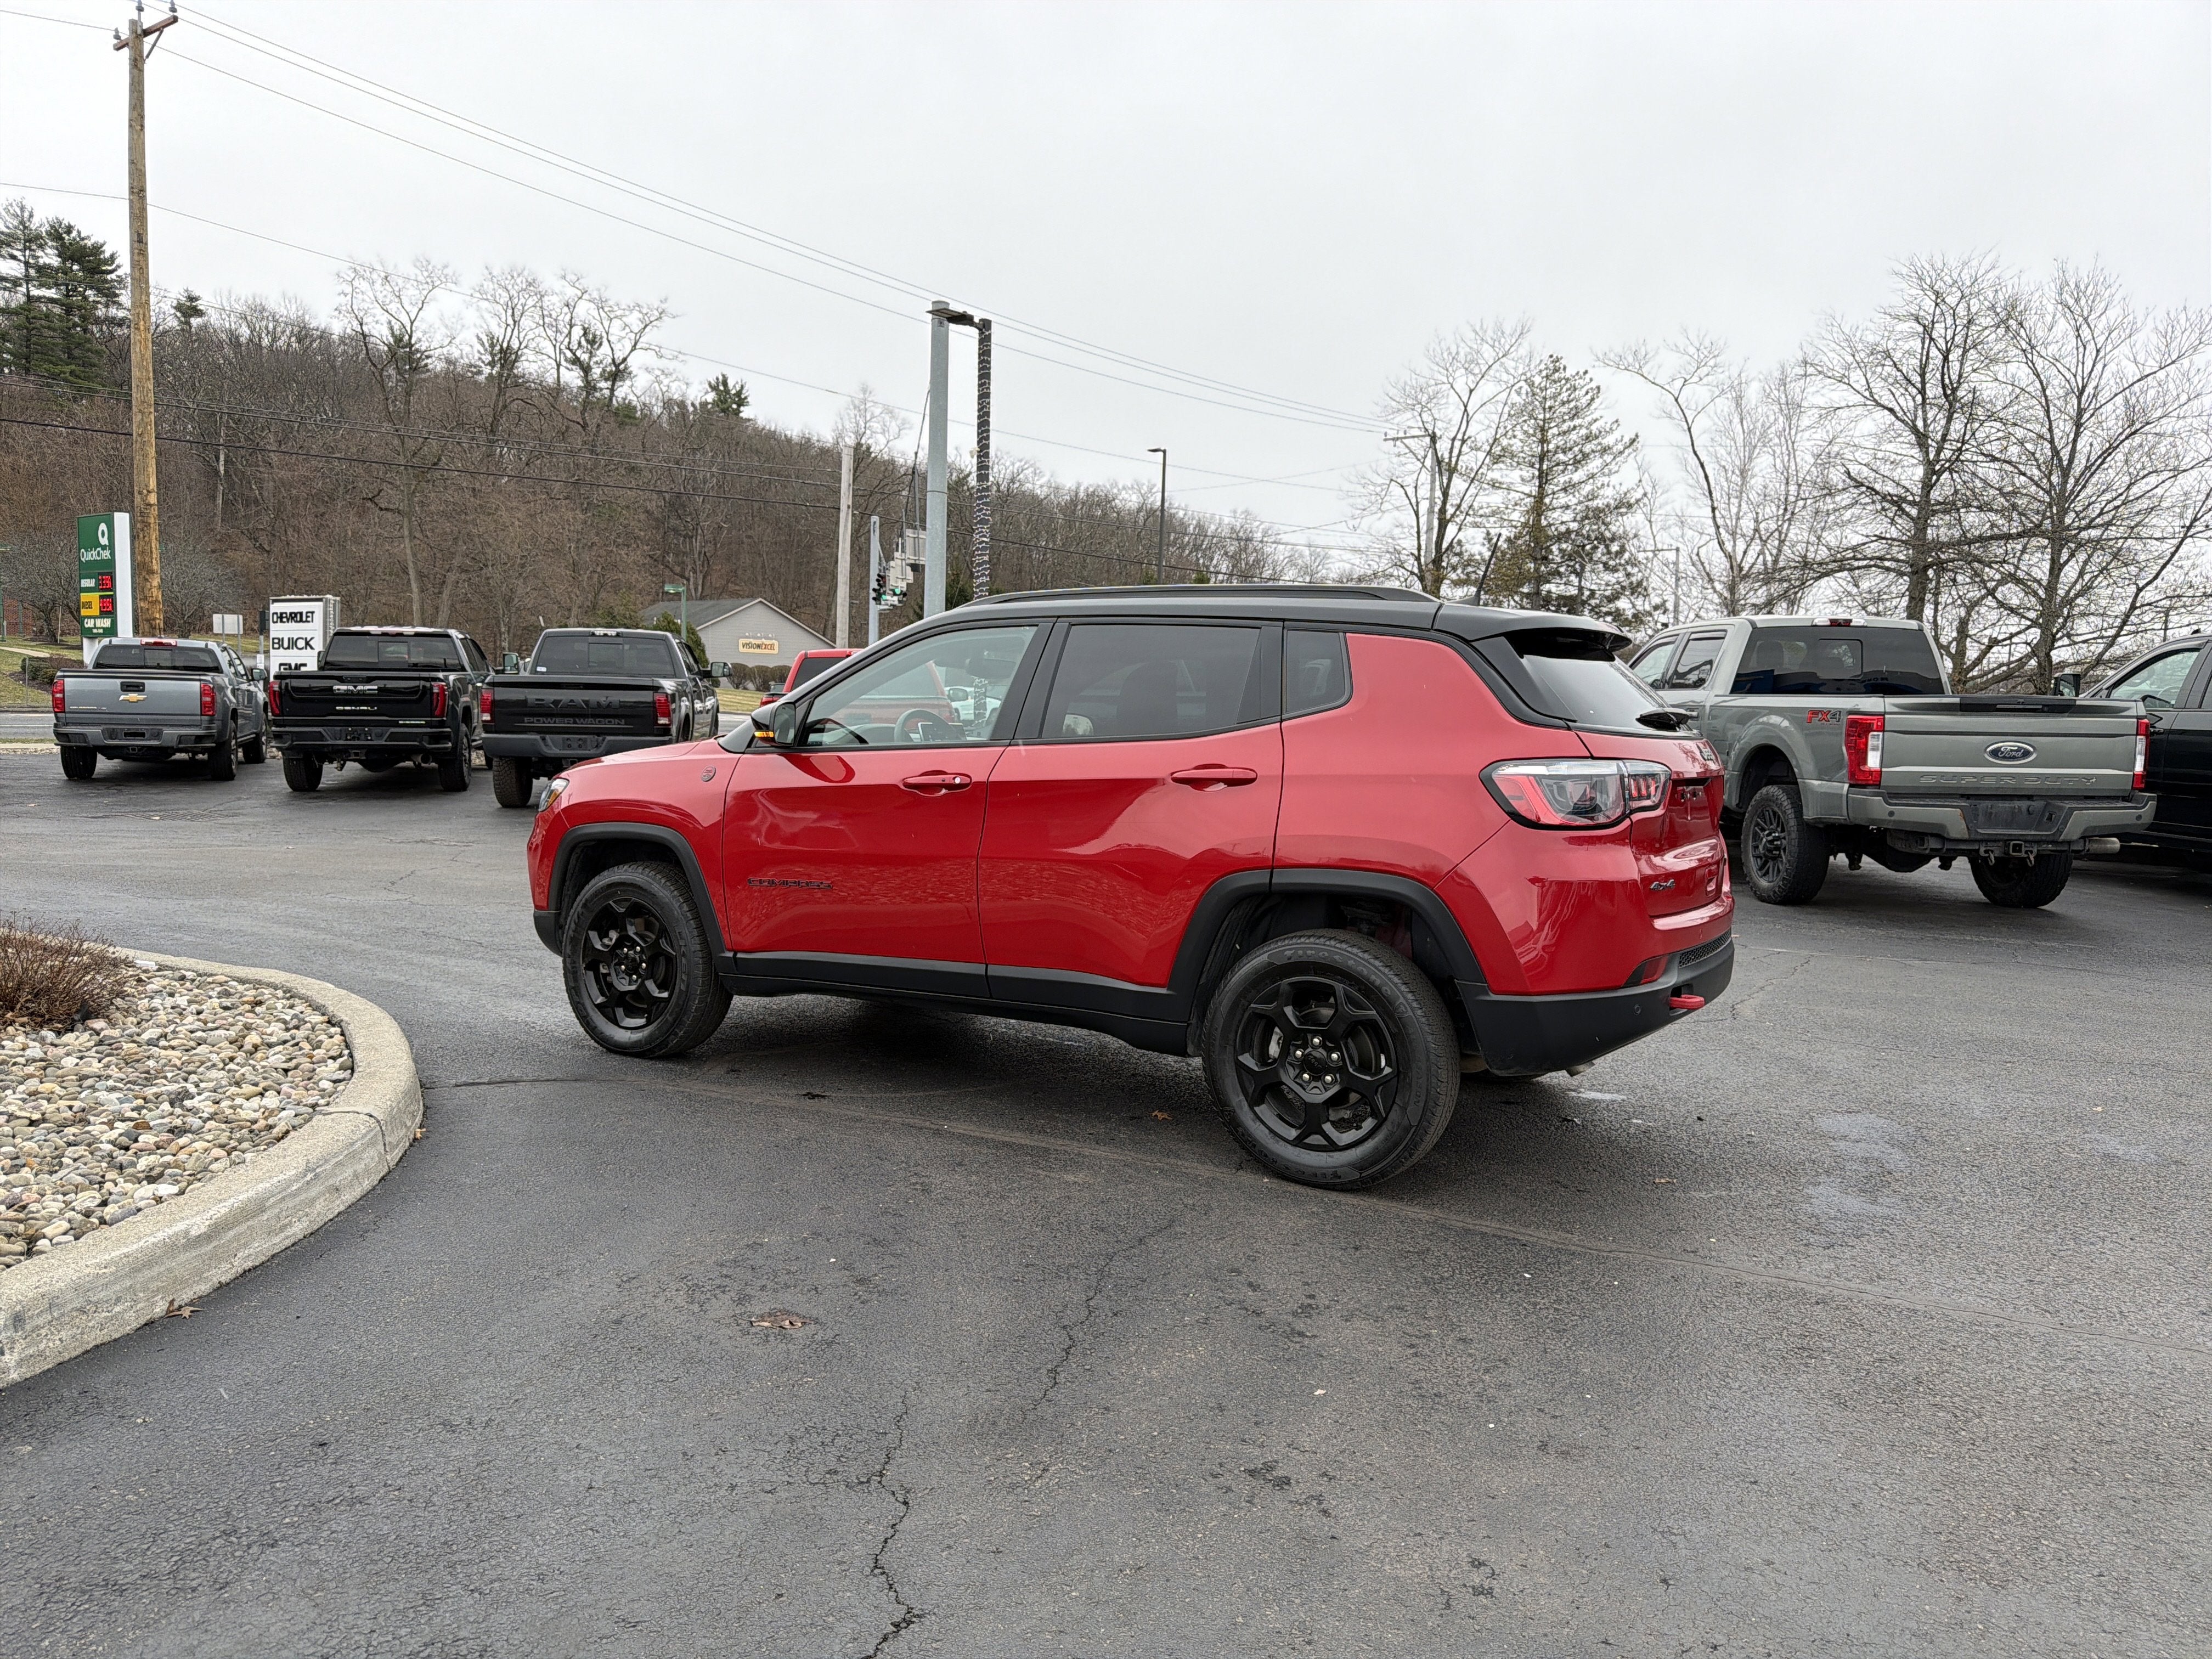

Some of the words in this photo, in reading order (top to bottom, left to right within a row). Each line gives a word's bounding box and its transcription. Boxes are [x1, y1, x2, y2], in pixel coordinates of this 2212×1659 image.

[98, 522, 109, 545] Q
[80, 546, 111, 563] QuickChek
[81, 601, 93, 610] DIESEL
[84, 618, 94, 628] CAR
[95, 618, 111, 628] WASH
[272, 611, 315, 624] CHEVROLET
[272, 637, 315, 650] BUICK
[332, 685, 378, 694] GMC
[527, 696, 620, 709] RAM
[1806, 710, 1842, 724] FX4
[1999, 746, 2023, 758] Ford
[1920, 775, 2017, 785] SUPER
[2024, 776, 2097, 785] DUTY
[747, 878, 833, 890] COMPASS
[1284, 949, 1392, 996] Firestone
